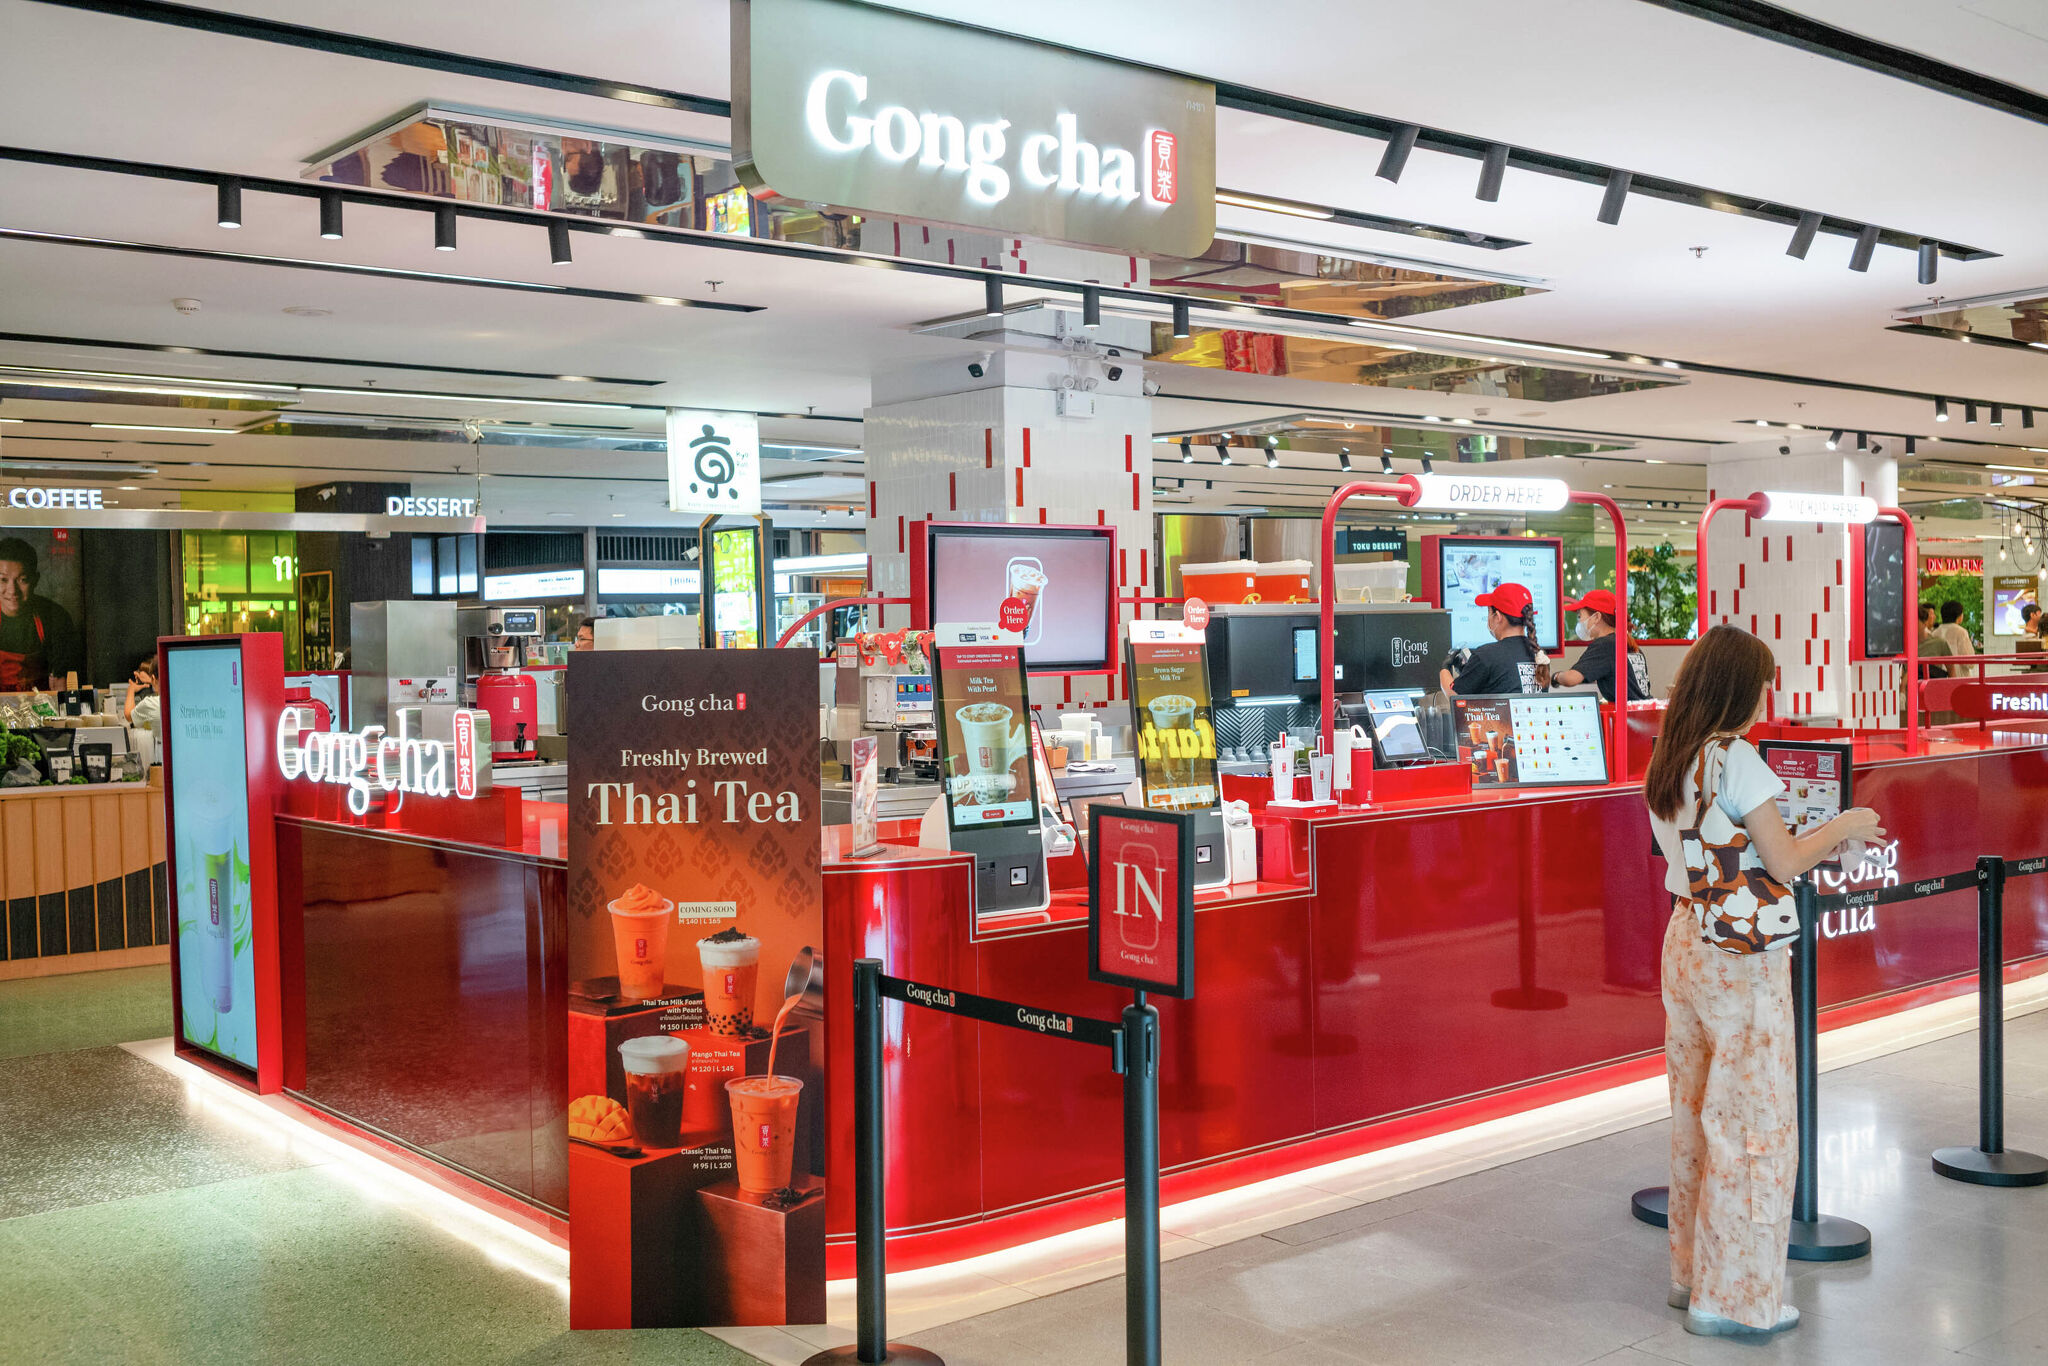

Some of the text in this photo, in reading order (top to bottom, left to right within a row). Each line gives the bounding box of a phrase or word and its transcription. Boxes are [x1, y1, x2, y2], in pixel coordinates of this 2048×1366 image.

[806, 70, 1141, 203] Gong cha
[9, 488, 104, 510] COFFEE
[1450, 484, 1543, 504] ORDER HERE
[388, 497, 475, 517] DESSERT
[1372, 542, 1402, 550] DESSERT
[1519, 557, 1537, 566] K025
[1928, 558, 1943, 571] DIN
[1945, 558, 1959, 571] TAI
[1003, 606, 1024, 615] Order
[1188, 606, 1206, 614] Order
[1007, 616, 1024, 624] Here
[1403, 639, 1429, 655] Gong
[1403, 651, 1420, 664] cha
[641, 694, 695, 717] Gong
[699, 693, 734, 711] cha
[1465, 712, 1500, 721] Thai Tea
[277, 707, 449, 815] Gong cha
[620, 748, 768, 771] Freshly Brewed
[588, 779, 802, 825] Thai Tea
[1120, 822, 1154, 834] Gong cha
[2018, 859, 2042, 872] Gong cha
[1113, 861, 1167, 922] IN
[1914, 880, 1941, 894] Gong cha
[1846, 891, 1875, 906] Gong cha
[1120, 950, 1154, 965] Gong cha
[907, 983, 949, 1006] Gong cha
[1017, 1008, 1066, 1031] Gong cha
